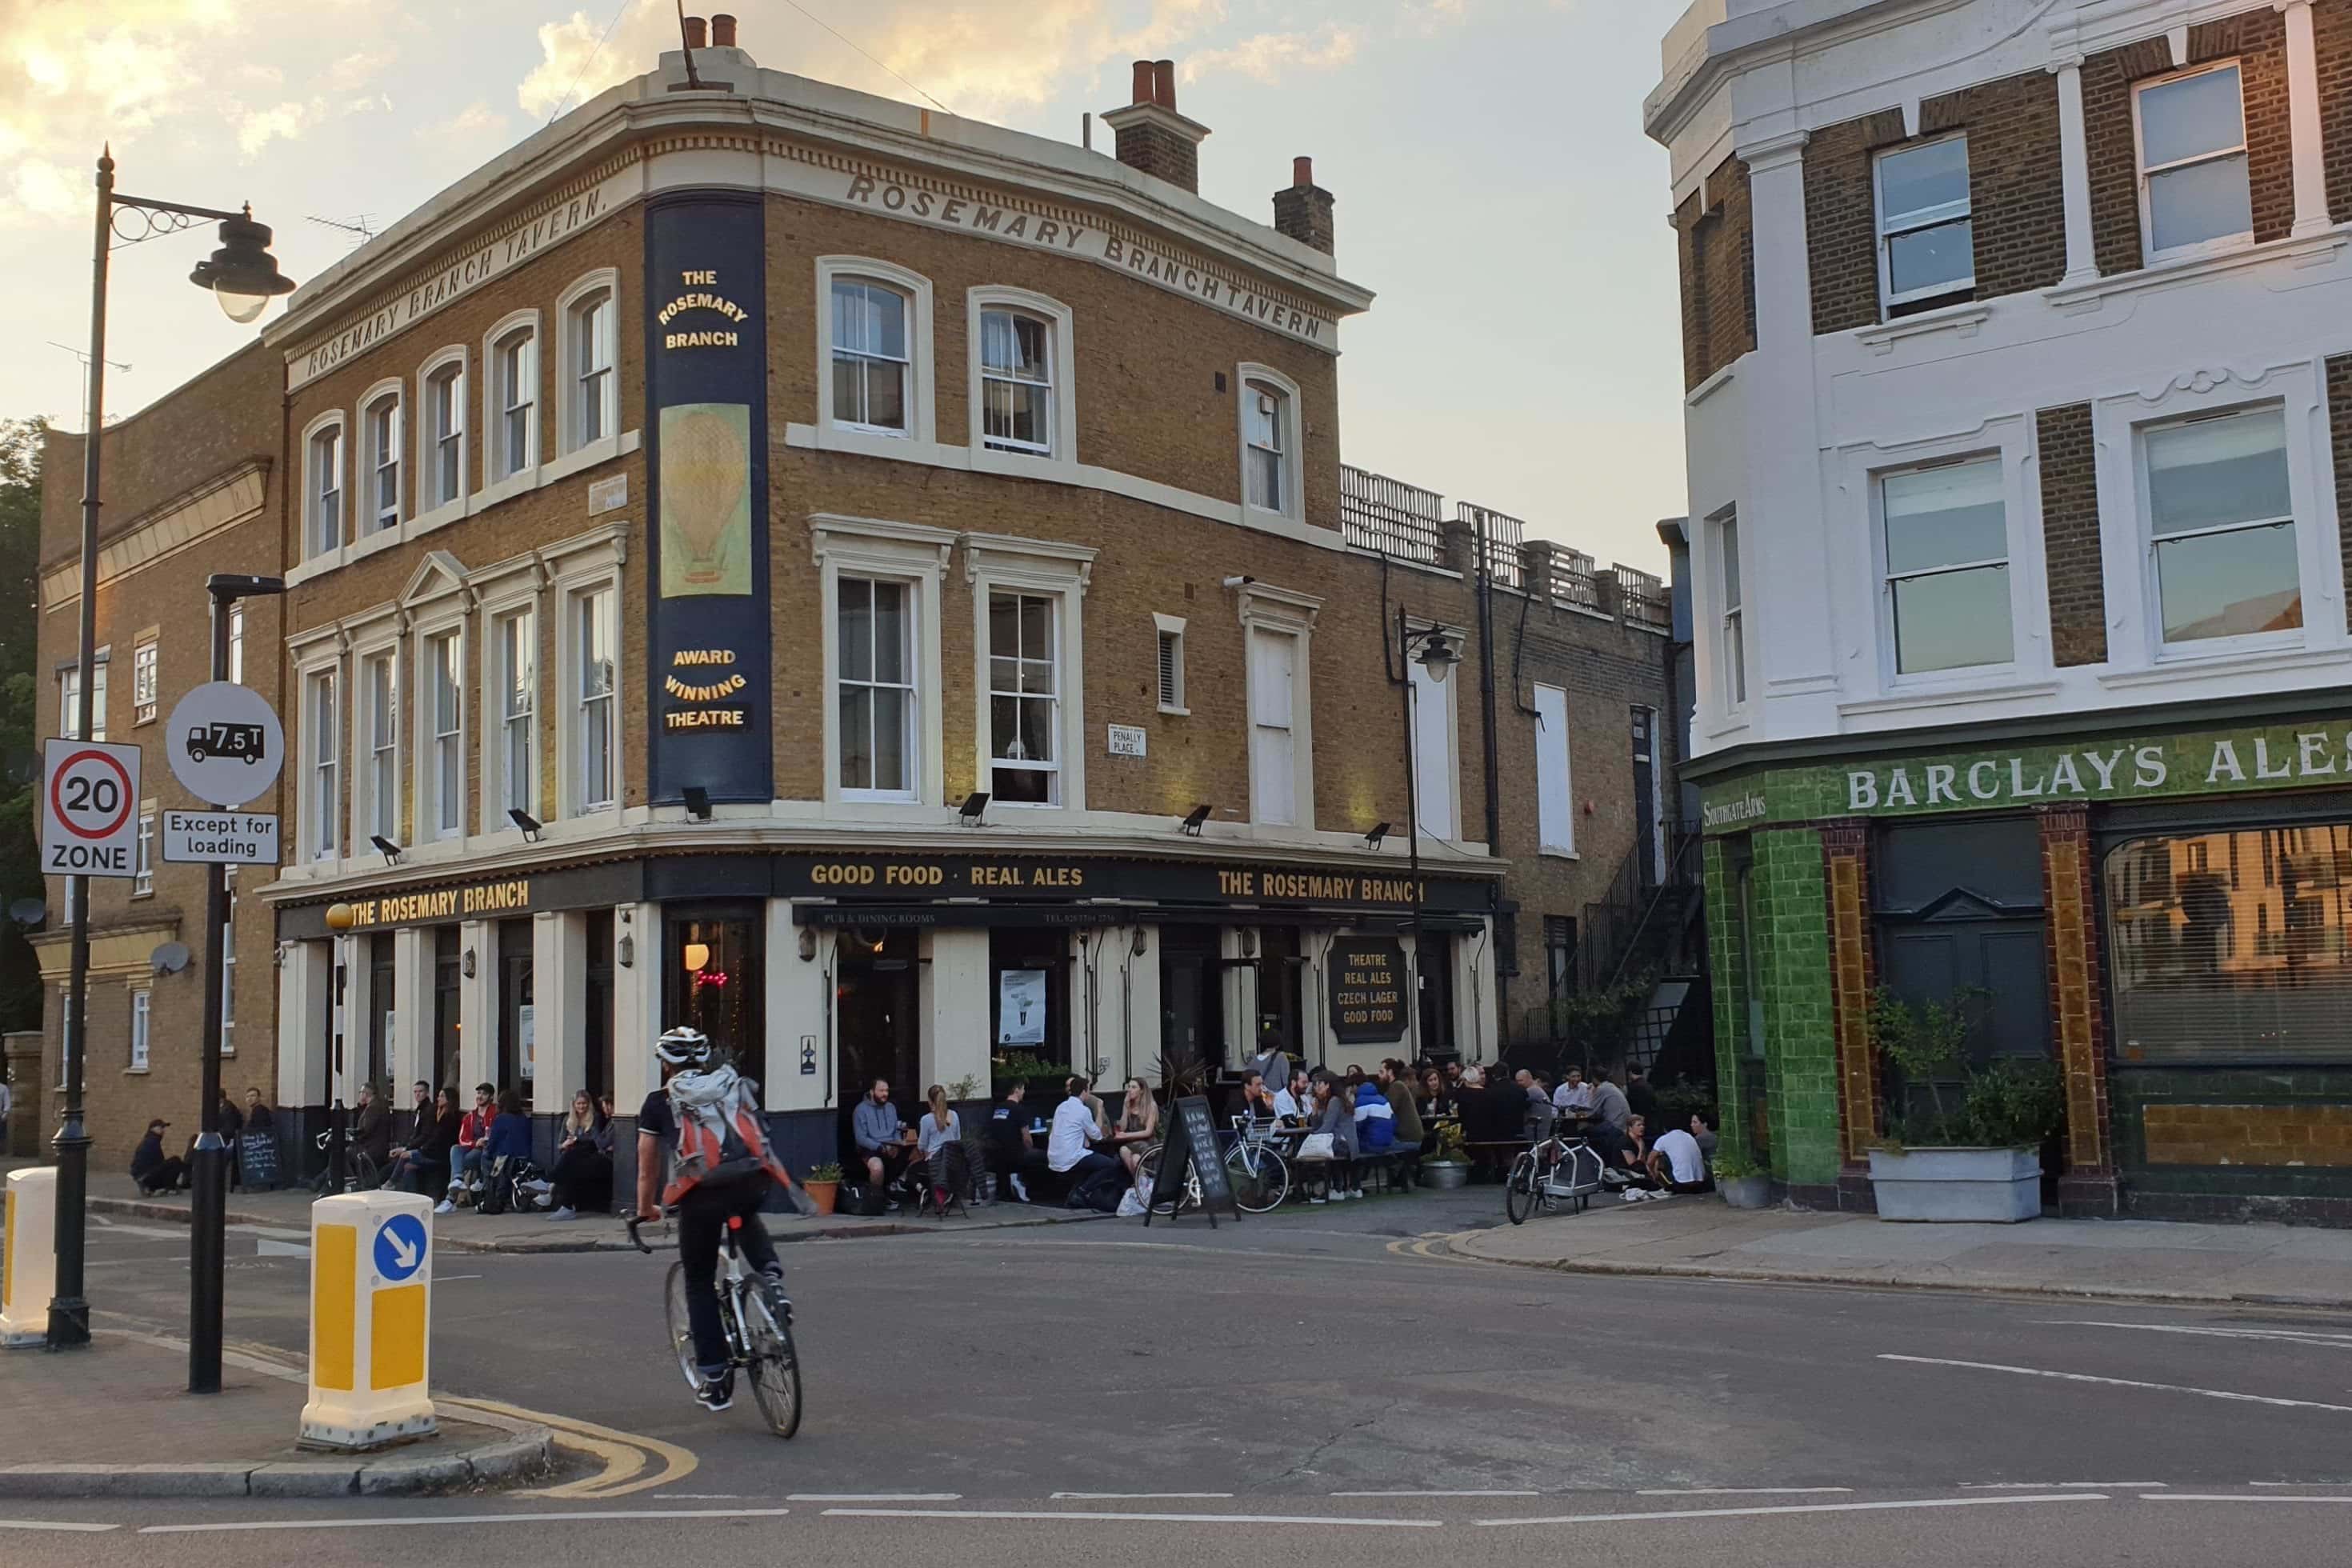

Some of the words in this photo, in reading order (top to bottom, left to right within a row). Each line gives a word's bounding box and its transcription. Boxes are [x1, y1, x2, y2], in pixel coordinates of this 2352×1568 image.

[846, 175, 1084, 249] ROSEMARY
[1104, 236, 1219, 300] BRANCH
[1226, 284, 1320, 339] TAVERN
[682, 270, 718, 285] THE
[307, 304, 399, 378] ROSEMARY
[409, 249, 493, 318] BRANCH
[658, 294, 749, 326] ROSEMARY
[666, 331, 738, 350] BRANCH
[673, 649, 736, 666] AWARD
[664, 674, 746, 702] WINNING
[666, 710, 744, 727] THEATRE
[1114, 731, 1142, 742] PENALLY
[1114, 742, 1134, 753] PLACE
[1847, 743, 2167, 810] BARCLAY'S
[66, 776, 118, 813] 20
[171, 815, 237, 834] Except
[246, 818, 272, 834] for
[187, 837, 257, 858] loading
[52, 845, 127, 870] ZONE
[811, 864, 875, 885] GOOD
[886, 866, 943, 886] FOOD
[971, 866, 1023, 886] REAL
[1033, 867, 1082, 886] ALES
[1218, 870, 1254, 895] THE
[1263, 874, 1354, 900] ROSEMARY
[350, 901, 376, 926] THE
[382, 890, 458, 922] ROSEMARY
[464, 880, 529, 913] BRANCH
[825, 914, 845, 923] PUB
[858, 914, 896, 923] DINING
[899, 914, 935, 923] ROOMS
[1348, 954, 1387, 966] THEATRE
[1345, 972, 1367, 985] REAL
[1370, 971, 1392, 984] ALES
[1338, 992, 1366, 1005] CZECH
[1370, 991, 1398, 1003] LAGER
[1343, 1010, 1368, 1023] GOOD
[1370, 1010, 1394, 1022] FOOD
